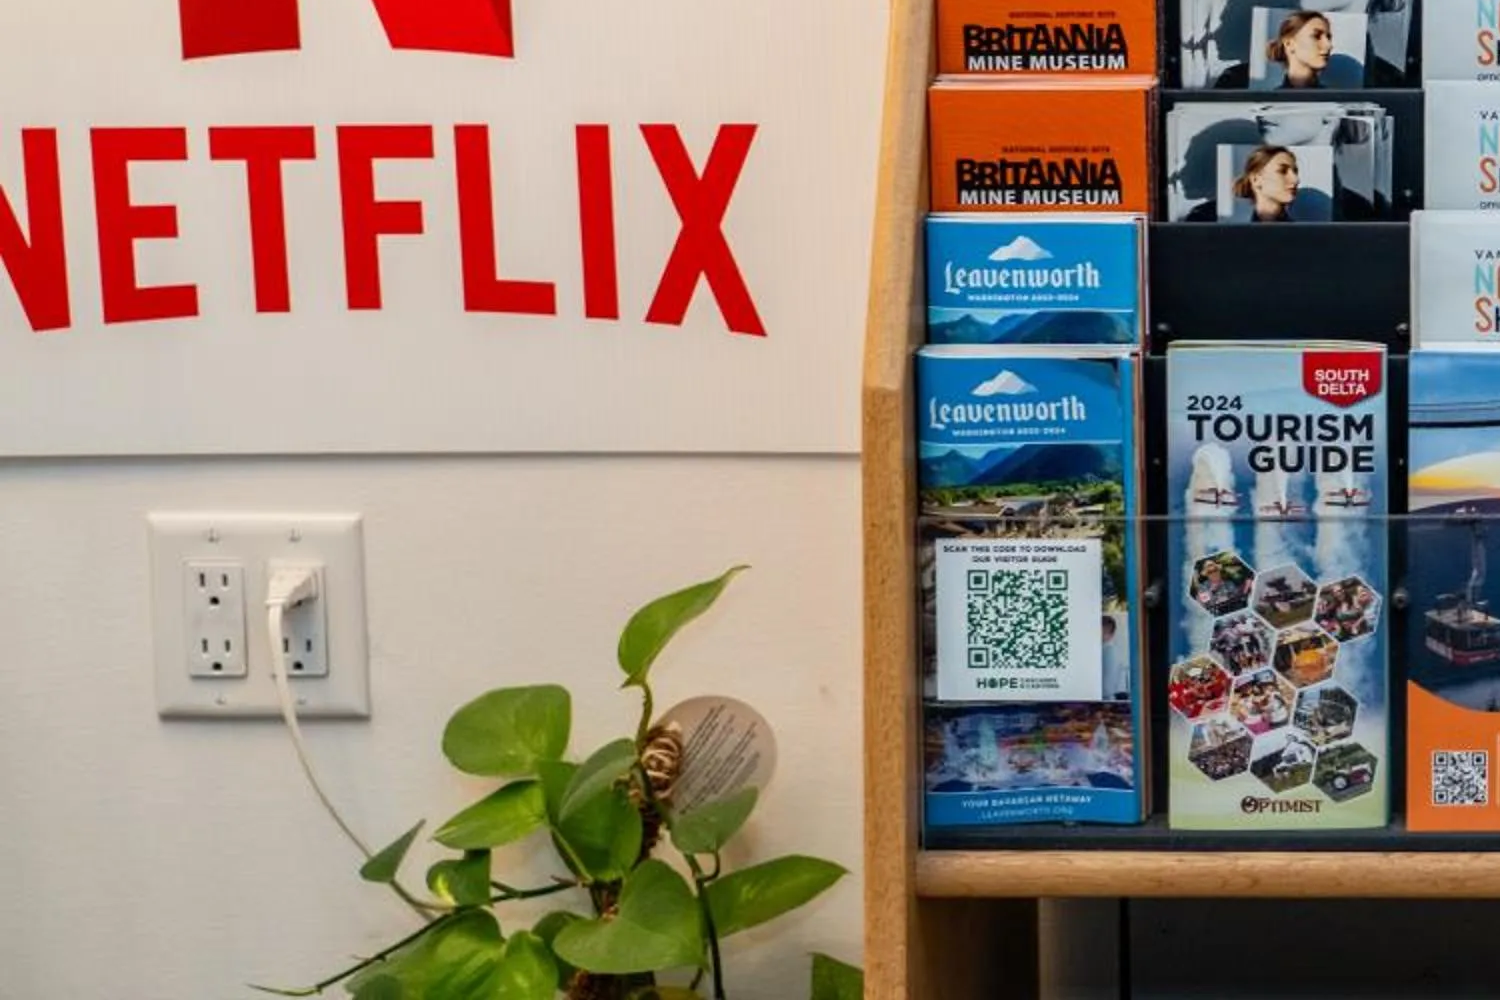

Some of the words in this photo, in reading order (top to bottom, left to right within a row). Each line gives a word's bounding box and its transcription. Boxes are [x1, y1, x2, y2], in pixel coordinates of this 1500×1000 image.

[963, 24, 1128, 51] BRITANNIA
[967, 56, 1023, 72] MINE
[1029, 55, 1126, 71] MUSEUM
[0, 124, 768, 337] NETFLIX
[944, 261, 1100, 295] Leavenworth
[1315, 369, 1370, 382] SOUTH
[1318, 384, 1367, 395] DELTA
[1187, 396, 1242, 411] 2024
[1187, 414, 1373, 442] TOURISM
[1248, 445, 1375, 473] GUIDE
